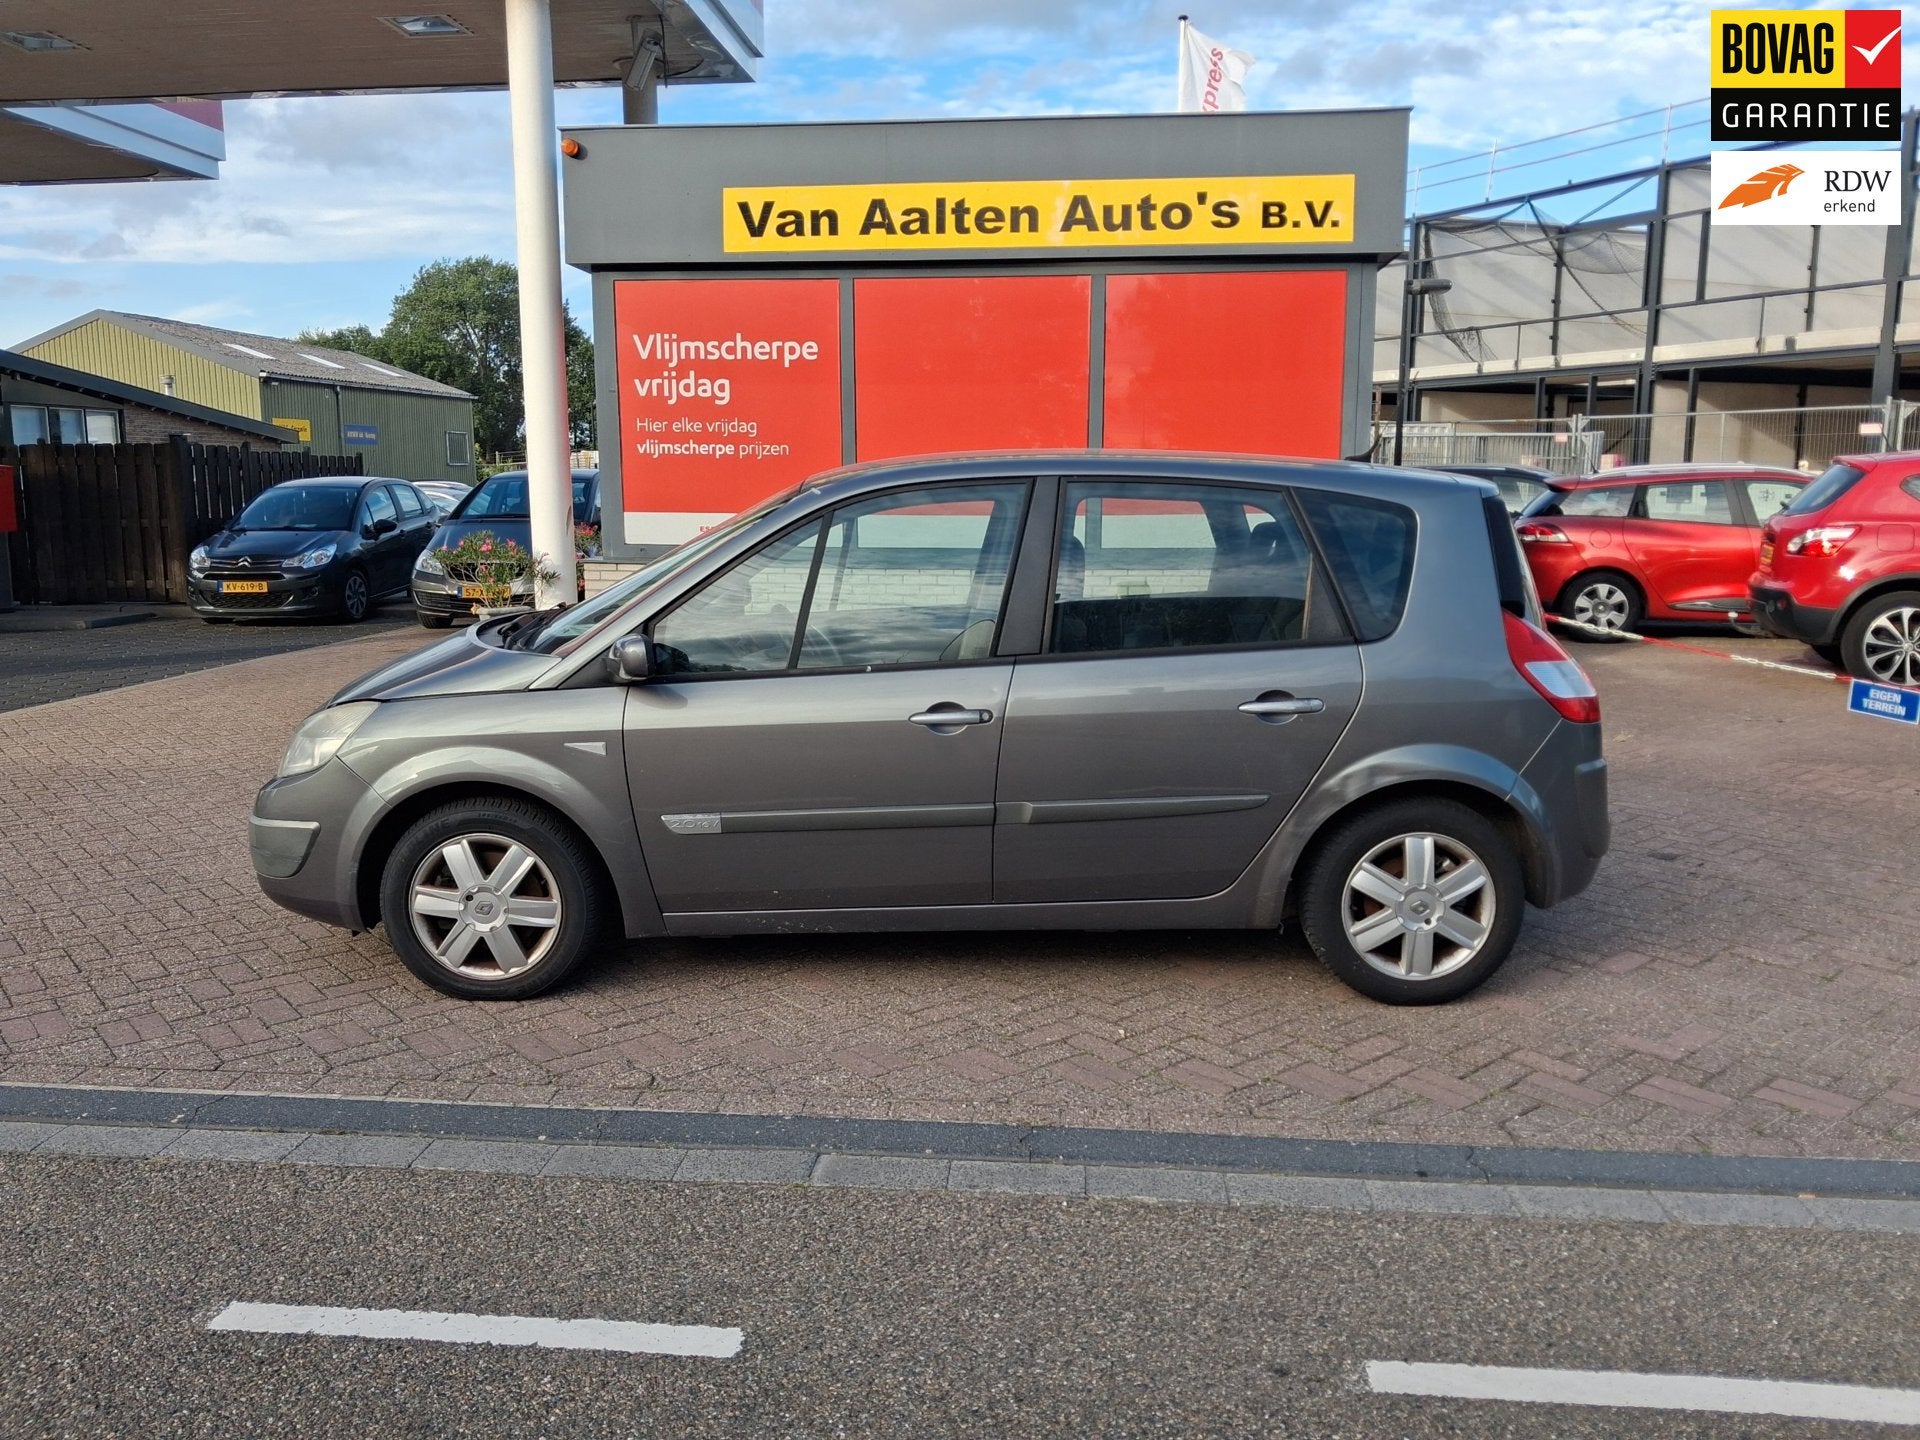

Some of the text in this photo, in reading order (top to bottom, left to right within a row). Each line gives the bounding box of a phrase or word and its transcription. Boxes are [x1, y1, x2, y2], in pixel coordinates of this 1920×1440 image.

[737, 191, 1340, 238] Van Aalten Auto's B.V.
[632, 332, 819, 368] Vlijmscherpe
[634, 370, 731, 406] vrijdag
[636, 417, 758, 438] Hier elke vrijdag
[637, 439, 790, 460] vlijmscherpe prijzen
[1869, 688, 1902, 704] EIGEN
[1862, 698, 1906, 716] TERREIN
